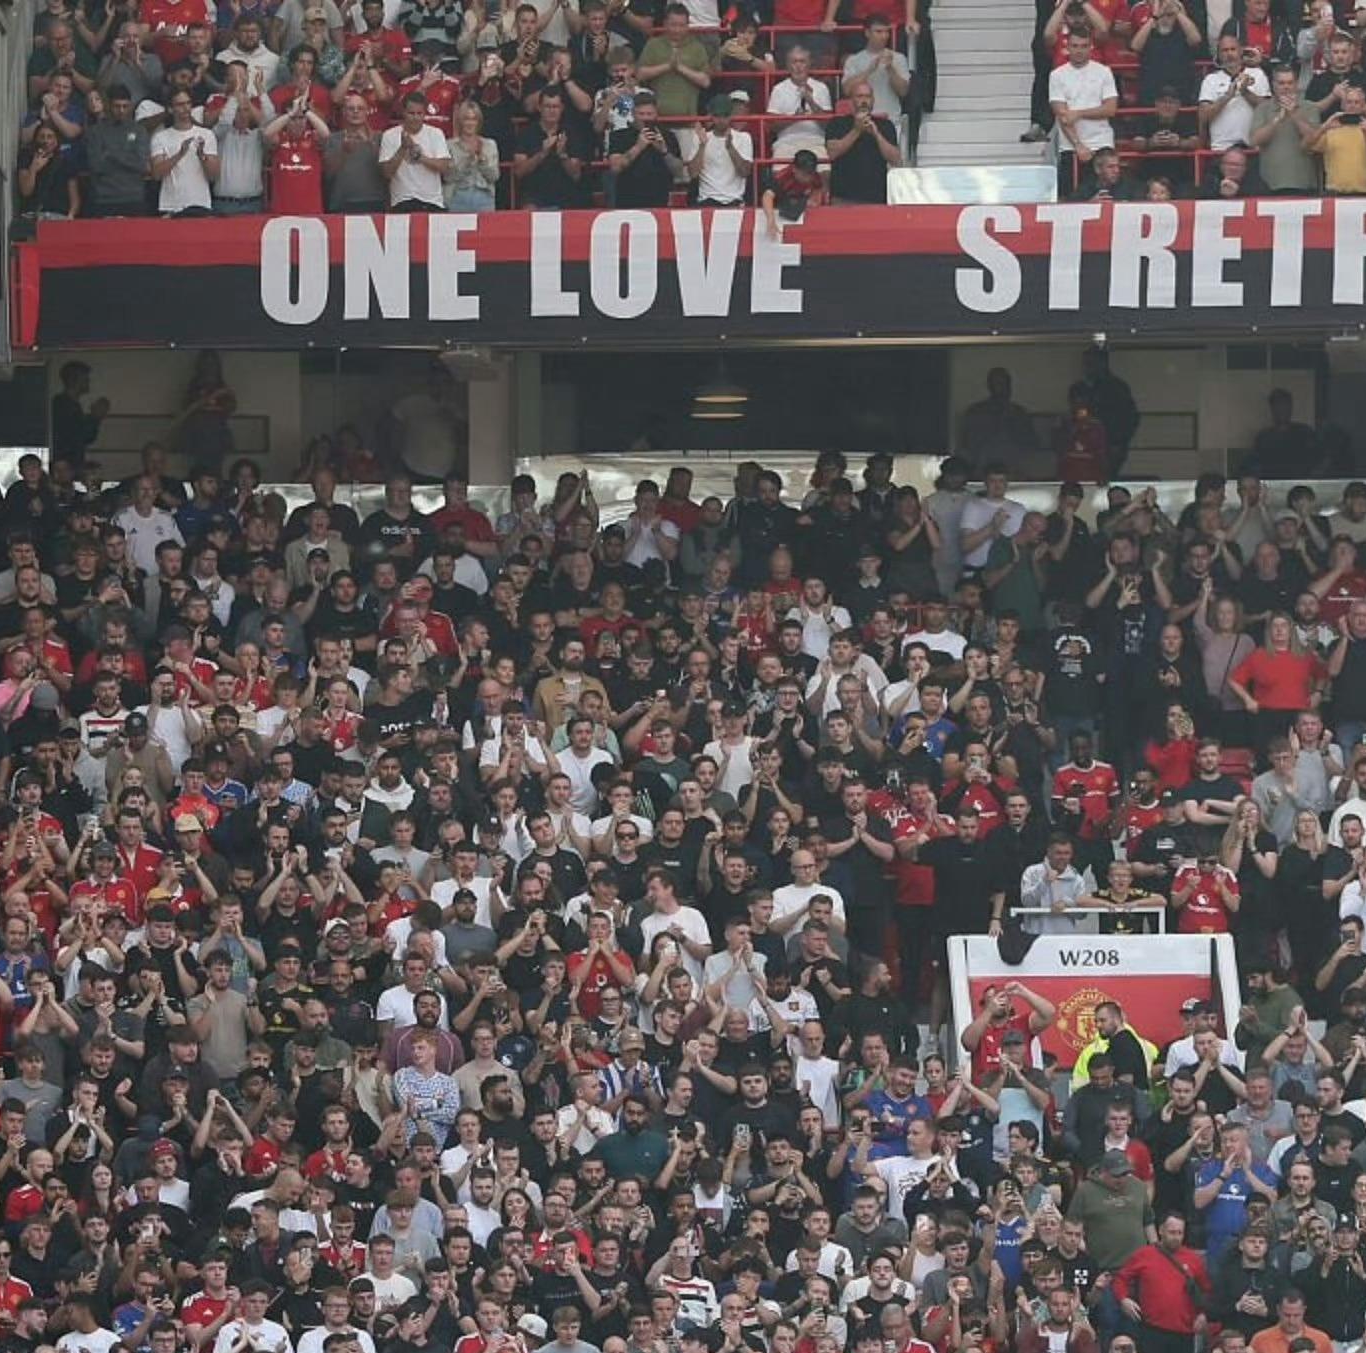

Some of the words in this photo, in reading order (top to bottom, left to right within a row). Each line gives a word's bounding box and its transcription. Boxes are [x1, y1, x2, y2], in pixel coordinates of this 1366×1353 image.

[260, 214, 480, 325] ONE
[530, 209, 804, 319] LOVE
[1059, 952, 1121, 967] W208
